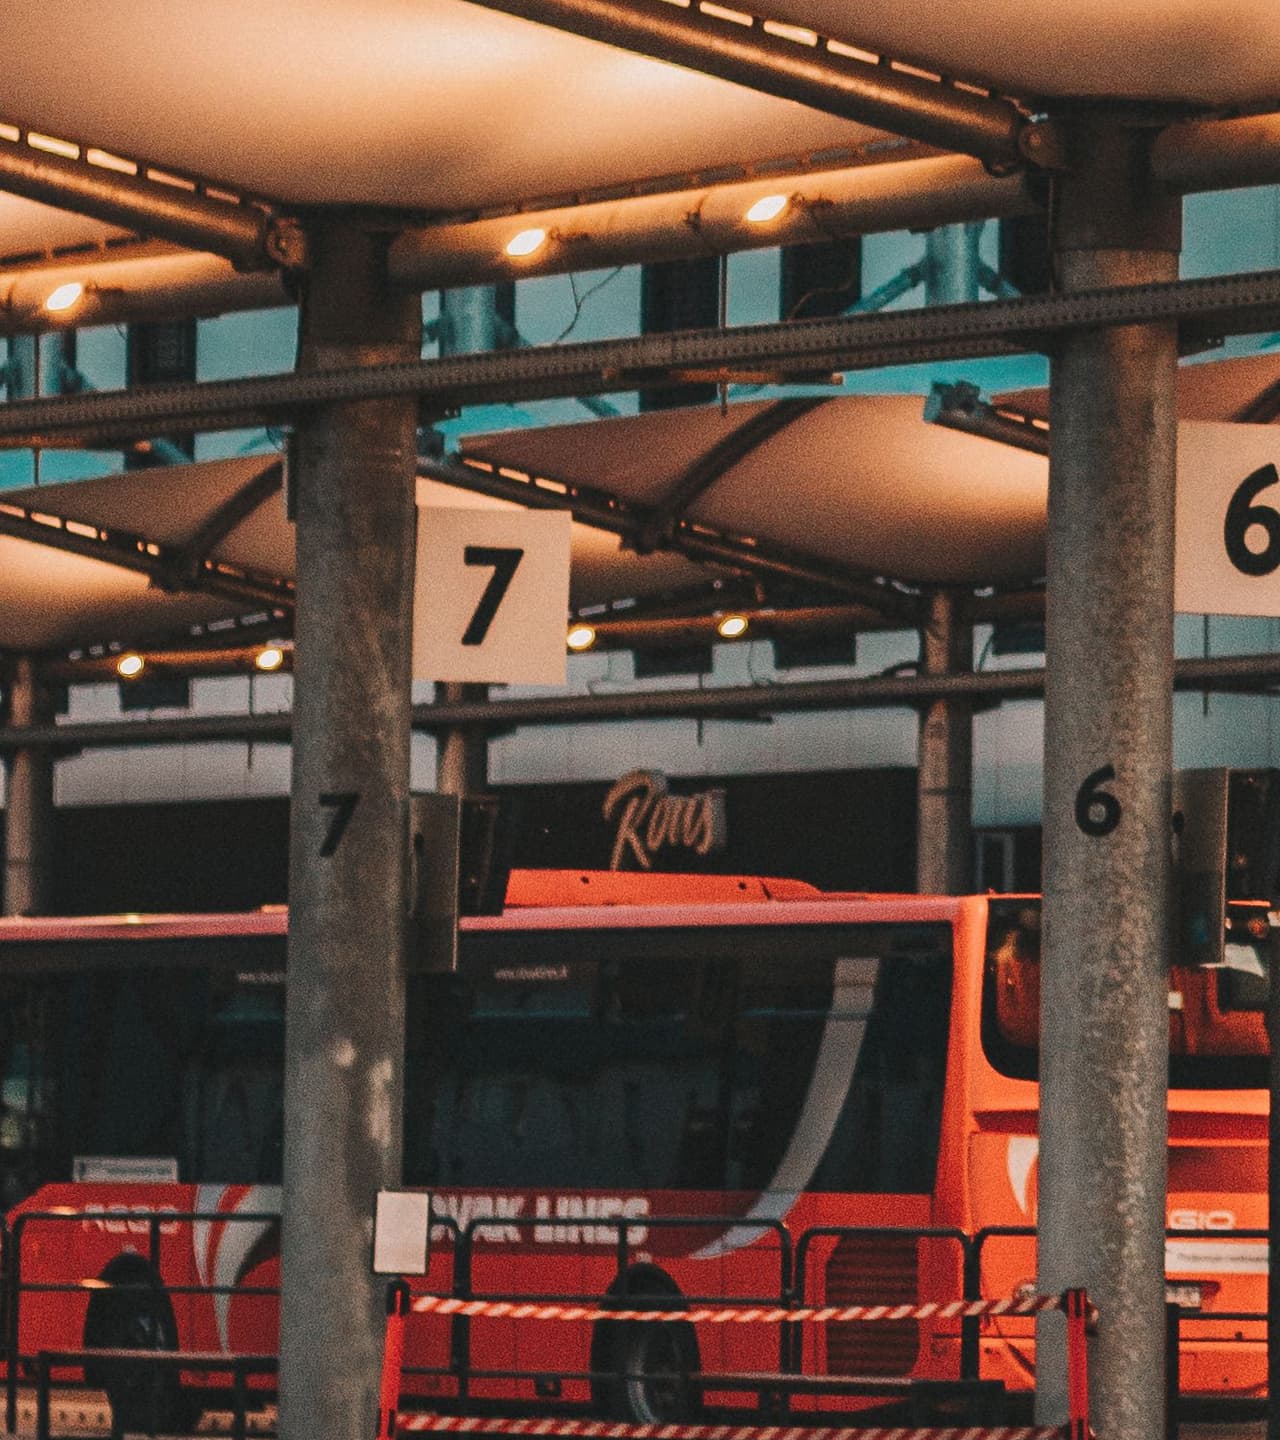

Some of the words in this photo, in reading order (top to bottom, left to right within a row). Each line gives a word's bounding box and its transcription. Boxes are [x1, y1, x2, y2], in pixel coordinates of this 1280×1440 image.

[462, 545, 525, 647] 7
[319, 791, 359, 858] 7
[1074, 763, 1122, 838] 6
[431, 1194, 526, 1243] OVAK
[533, 1195, 650, 1246] LINES
[1169, 1208, 1236, 1230] GIO
